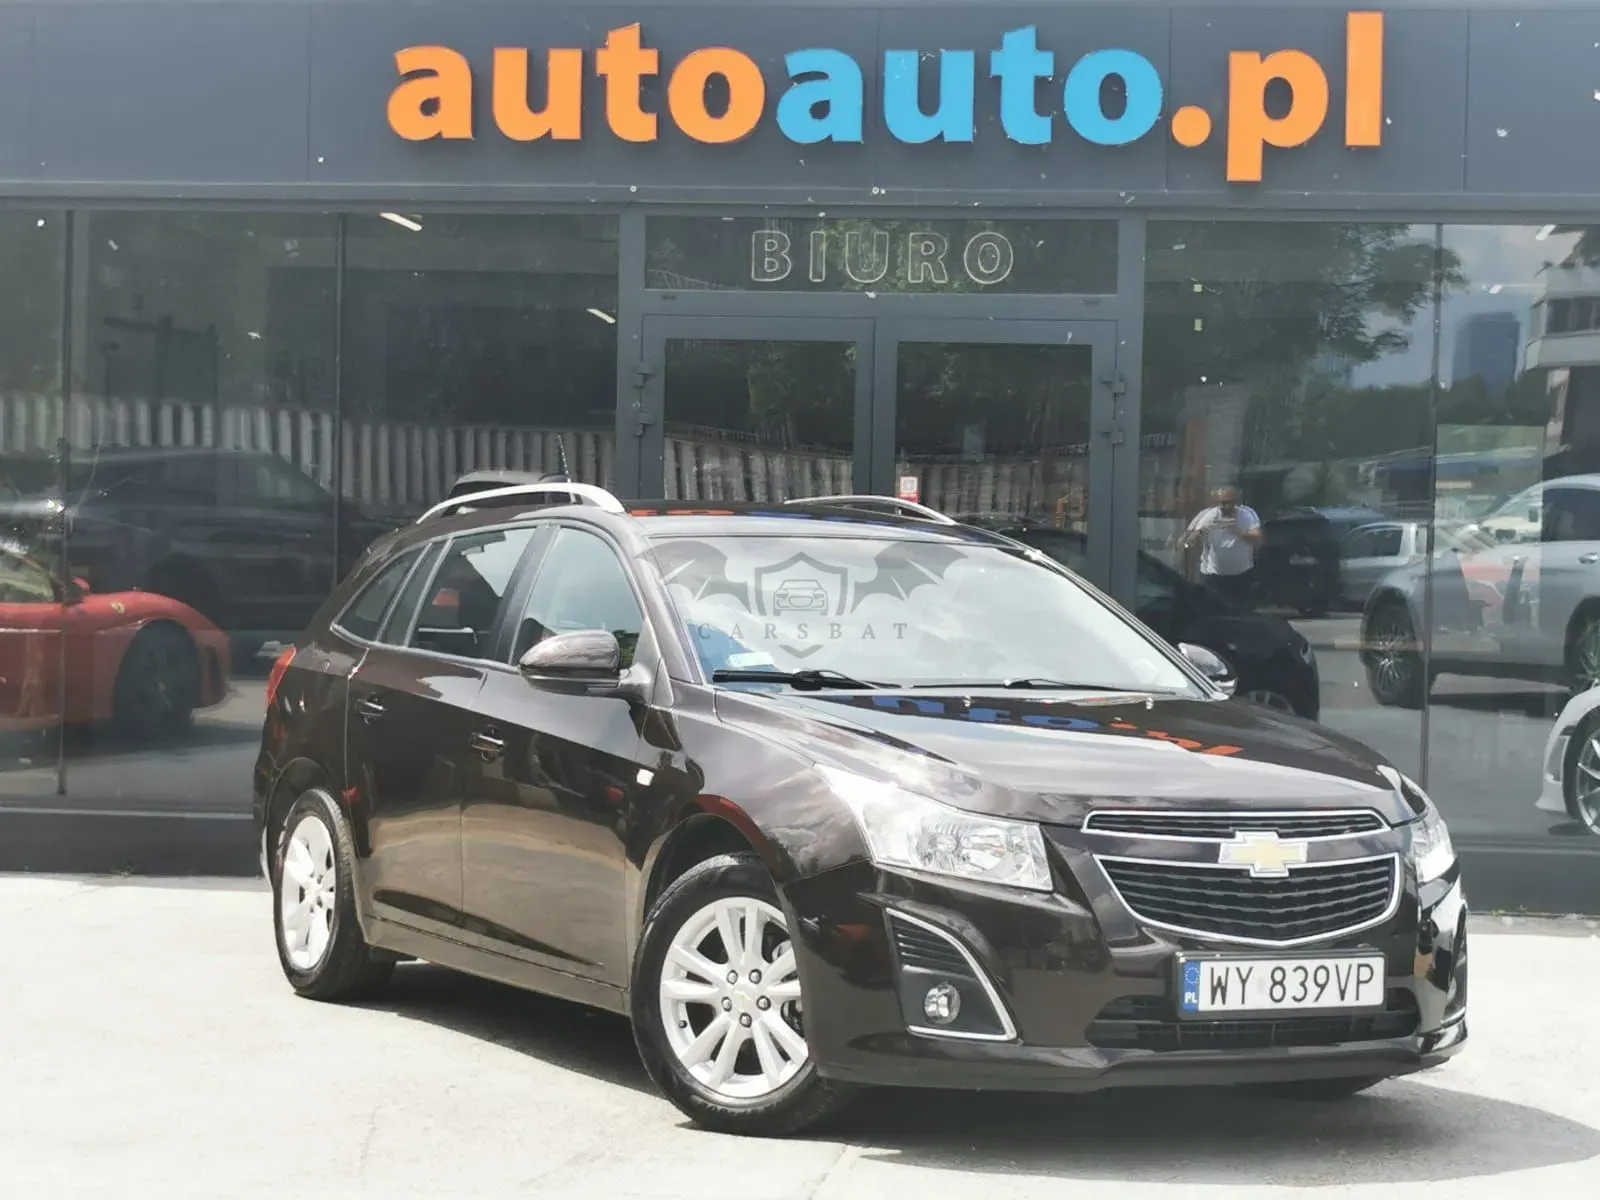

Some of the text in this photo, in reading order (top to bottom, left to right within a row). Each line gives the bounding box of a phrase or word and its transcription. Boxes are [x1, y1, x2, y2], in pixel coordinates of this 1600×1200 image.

[387, 11, 1384, 183] autoauto.pl
[751, 230, 1014, 285] BIURO
[1184, 991, 1198, 1004] PL
[1210, 963, 1375, 1005] WY 839VP
